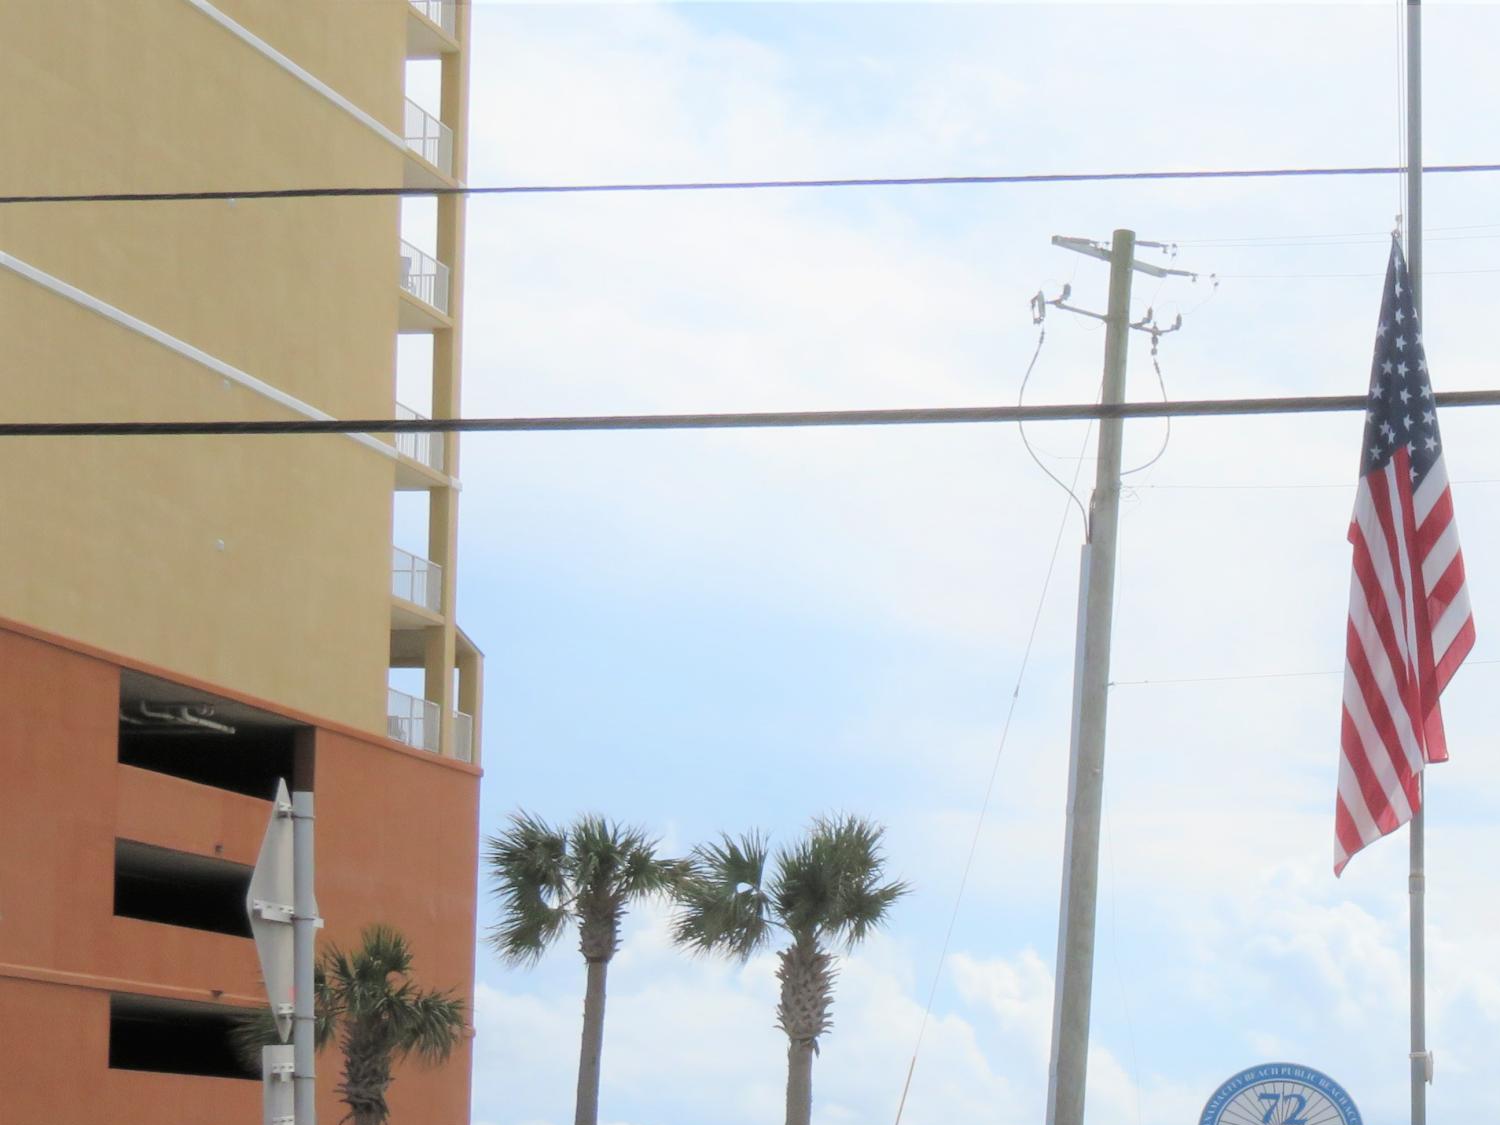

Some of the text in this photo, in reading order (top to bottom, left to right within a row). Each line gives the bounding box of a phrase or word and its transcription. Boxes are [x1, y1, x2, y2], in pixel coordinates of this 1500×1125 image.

[1222, 1079, 1243, 1096] CITY
[1244, 1067, 1279, 1082] BEACH
[1281, 1066, 1317, 1082] PUBLIC
